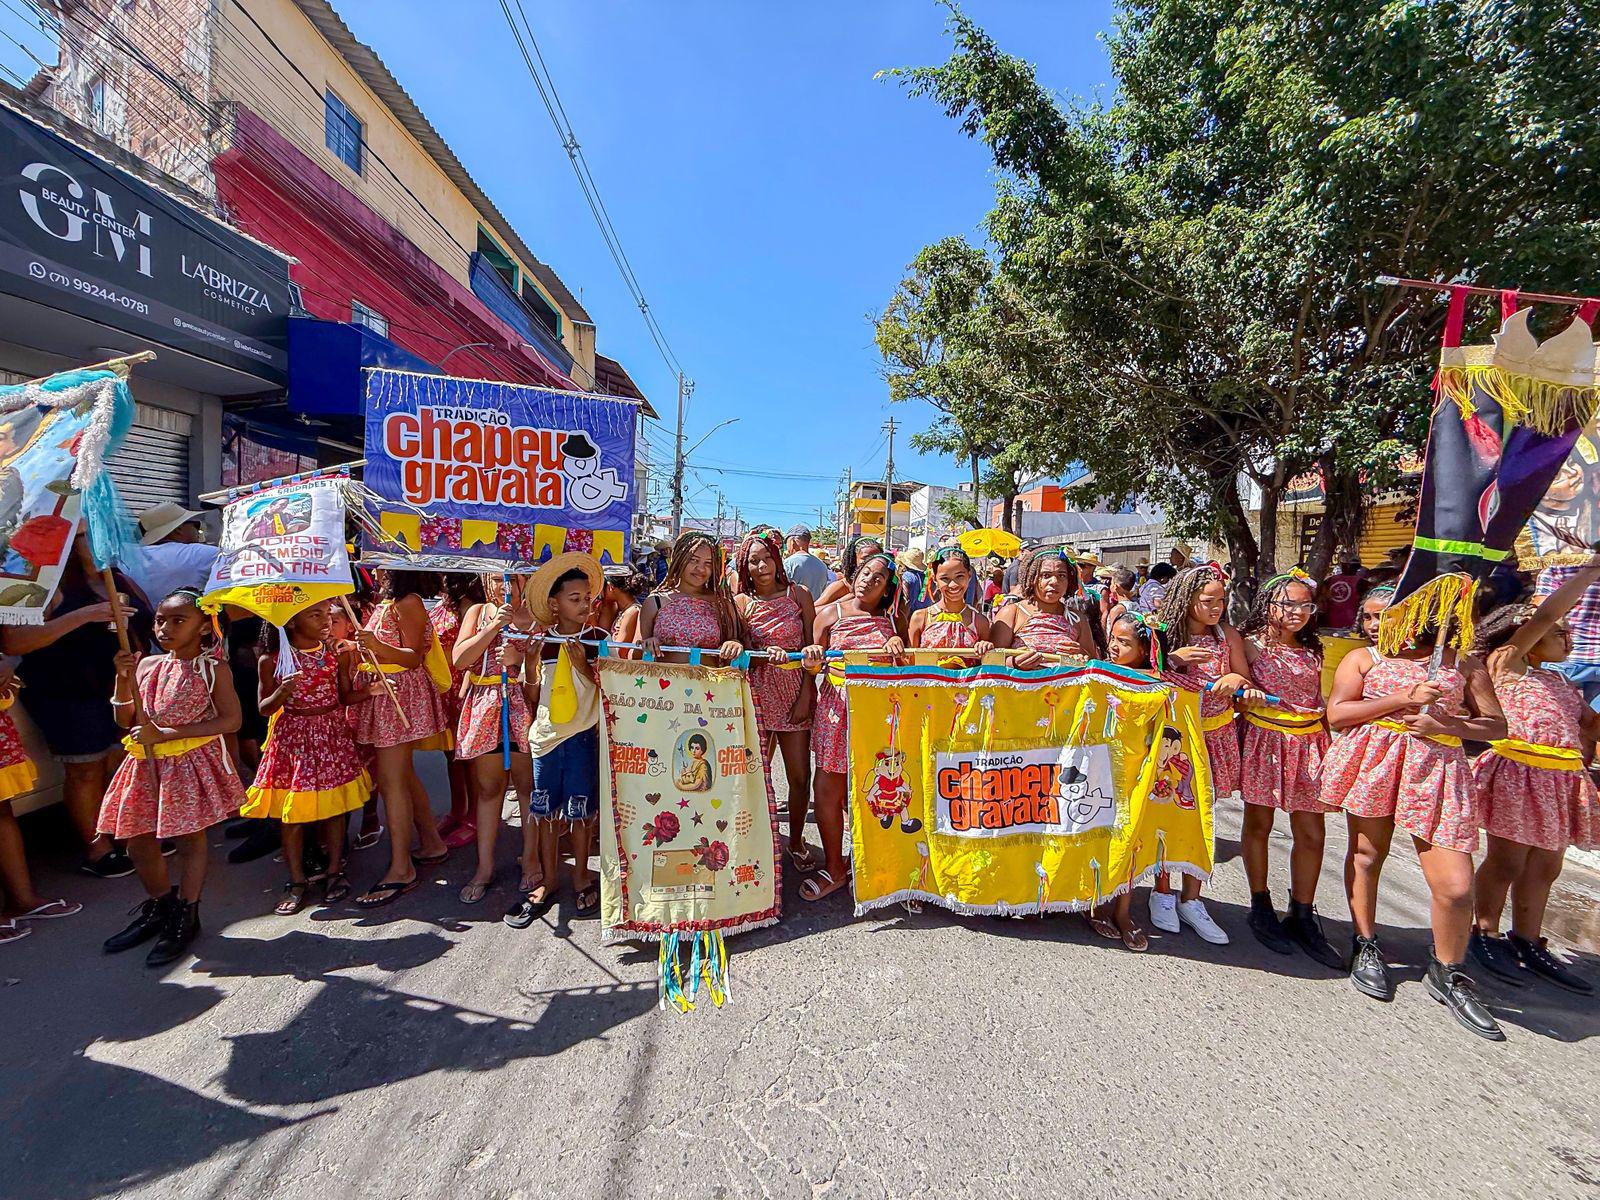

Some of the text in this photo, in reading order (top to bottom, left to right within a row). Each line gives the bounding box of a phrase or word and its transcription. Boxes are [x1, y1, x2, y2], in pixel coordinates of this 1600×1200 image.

[42, 187, 136, 240] BEAUTY CENTER
[50, 271, 149, 315] (71) 99244-0781
[203, 288, 256, 316] COSMETICS
[434, 407, 508, 426] TRADIÇÃO
[386, 408, 567, 471] chapeu
[404, 459, 562, 506] gravata
[241, 561, 329, 576] CANTAR
[608, 692, 636, 708] SÃO
[638, 696, 674, 712] JOÃO
[683, 703, 703, 714] DA
[975, 755, 1023, 766] TRADIÇÃO
[939, 761, 1062, 802] chapeu
[949, 794, 1061, 831] gravata
